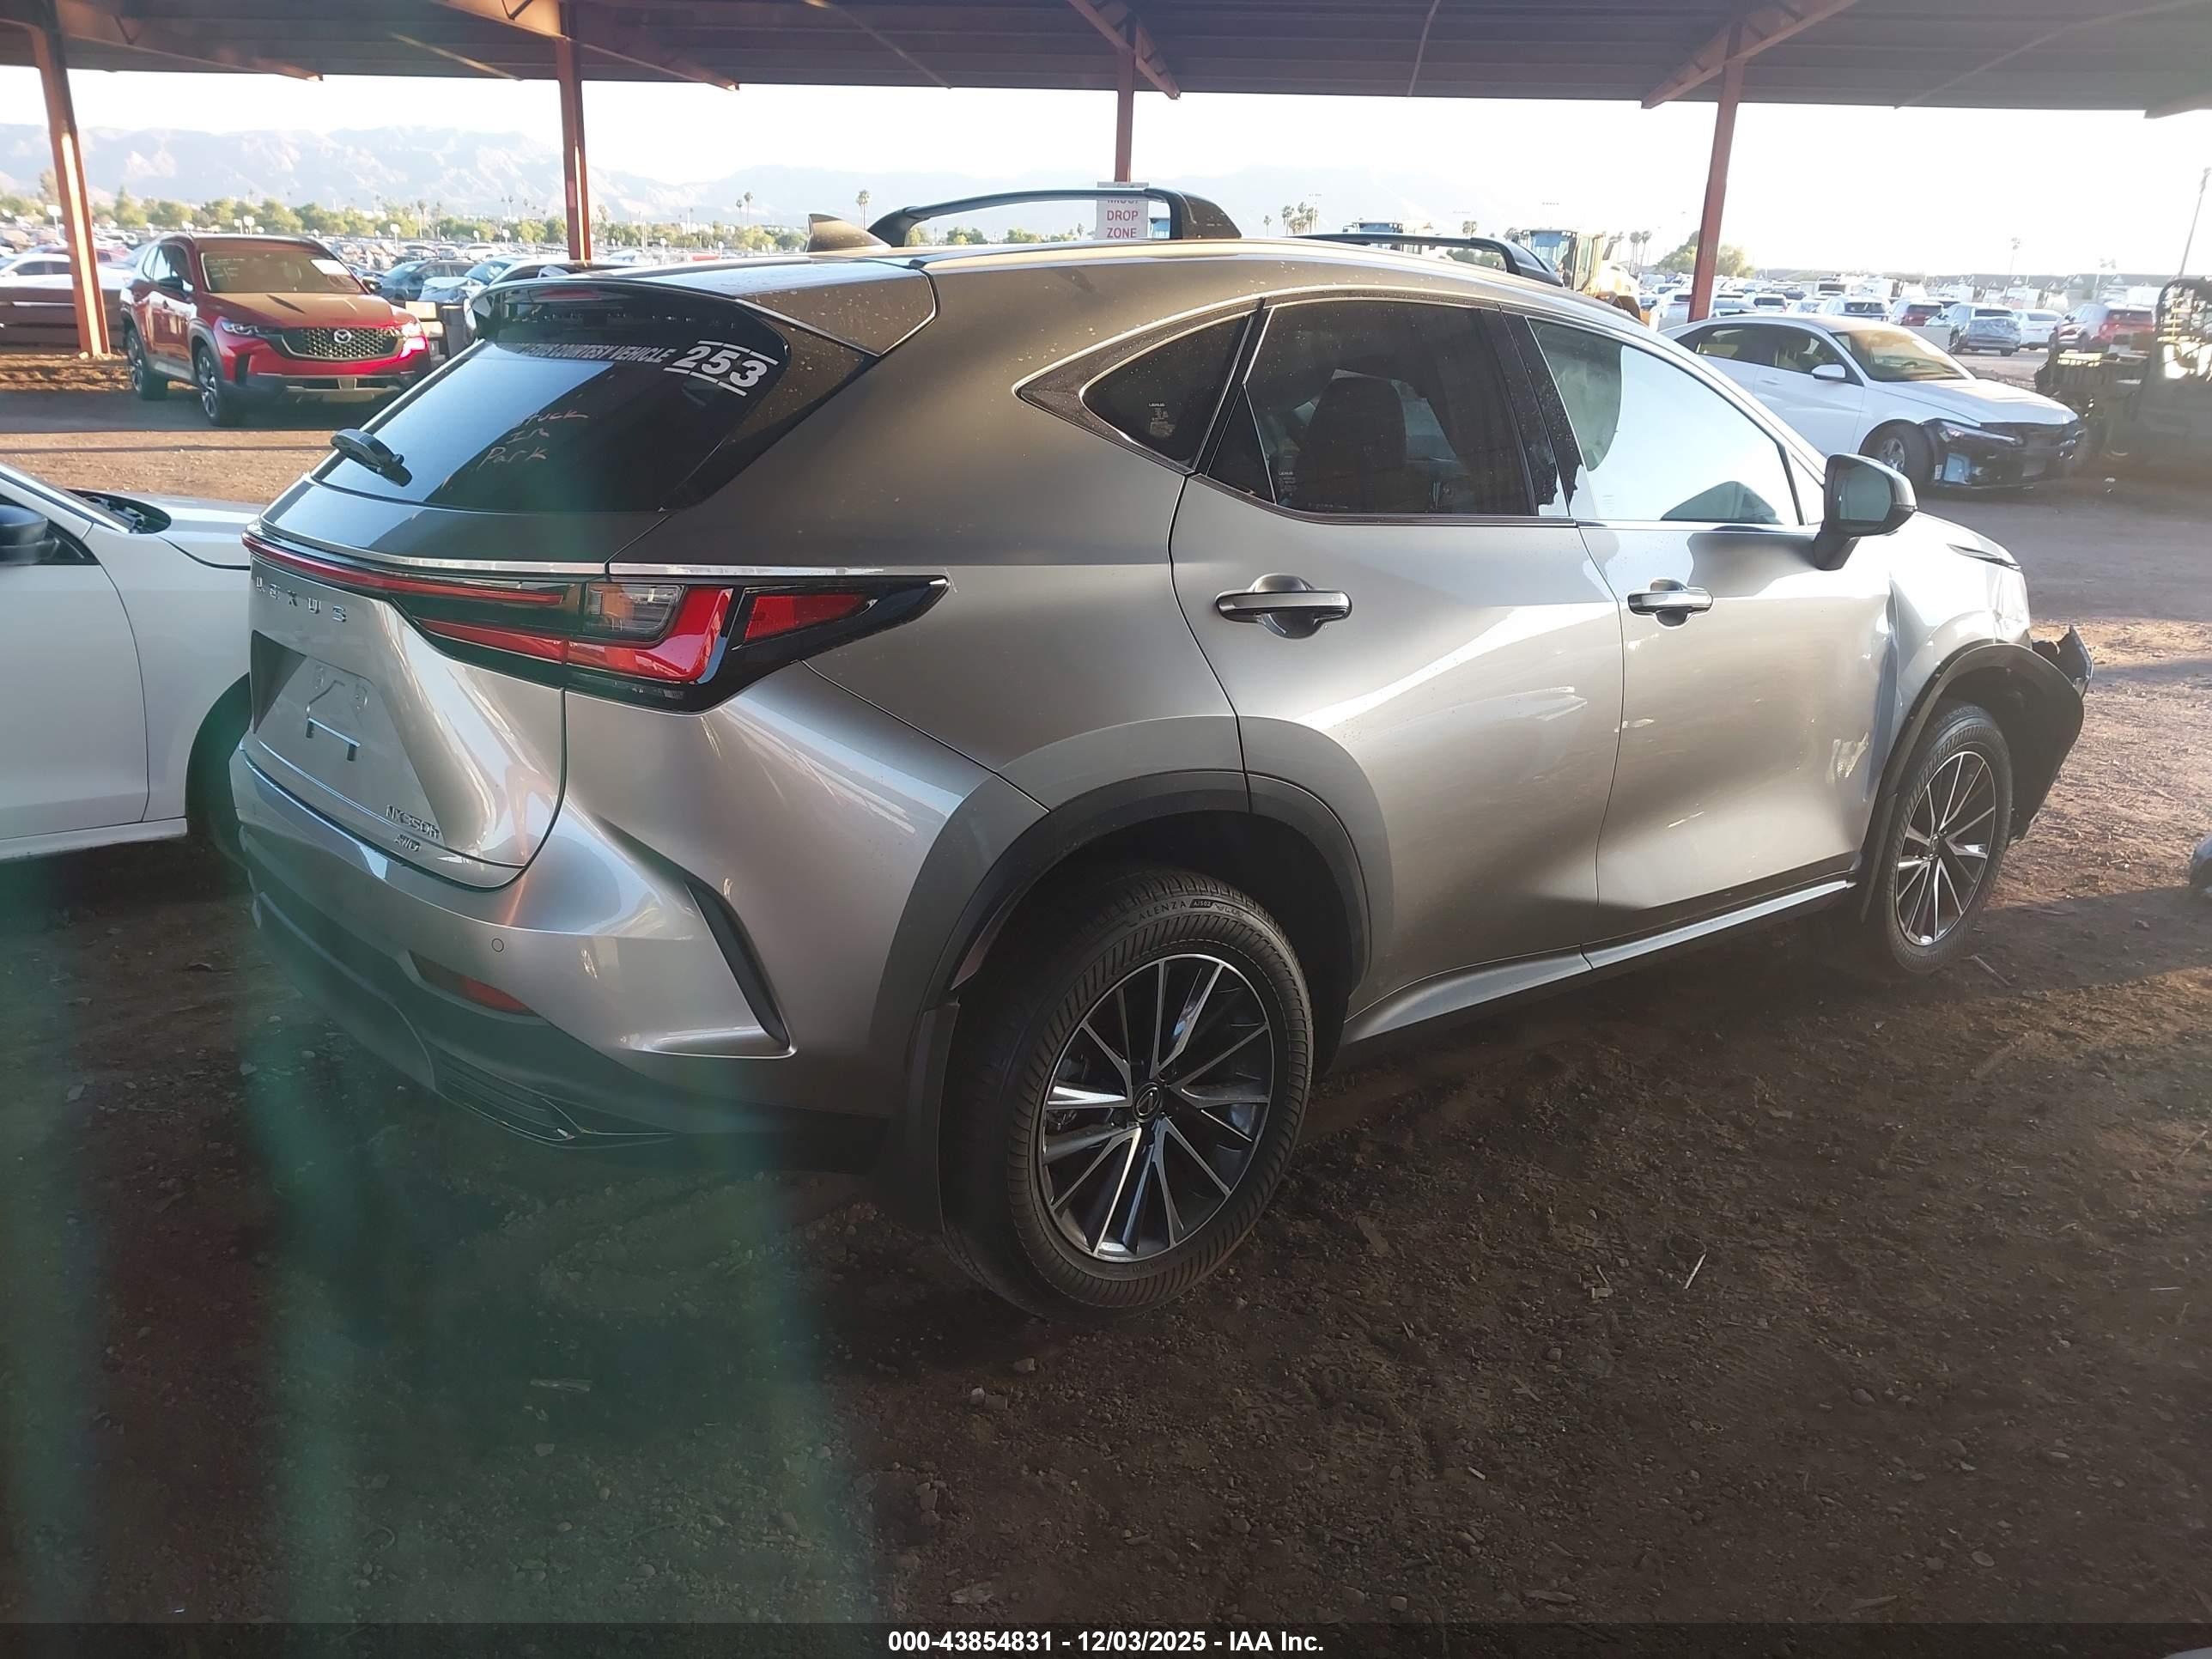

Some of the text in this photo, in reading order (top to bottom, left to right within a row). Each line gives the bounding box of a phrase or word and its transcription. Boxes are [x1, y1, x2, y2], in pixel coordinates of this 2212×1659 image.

[1107, 210, 1139, 221] DROP
[1107, 227, 1137, 238] ZONE
[549, 343, 619, 359] COURTESY
[608, 345, 678, 362] VEHICLE
[672, 345, 768, 387] 253
[520, 409, 589, 426] tuck
[476, 446, 548, 471] Park
[256, 576, 347, 623] LEXUS
[1139, 901, 1187, 921] ALENZA
